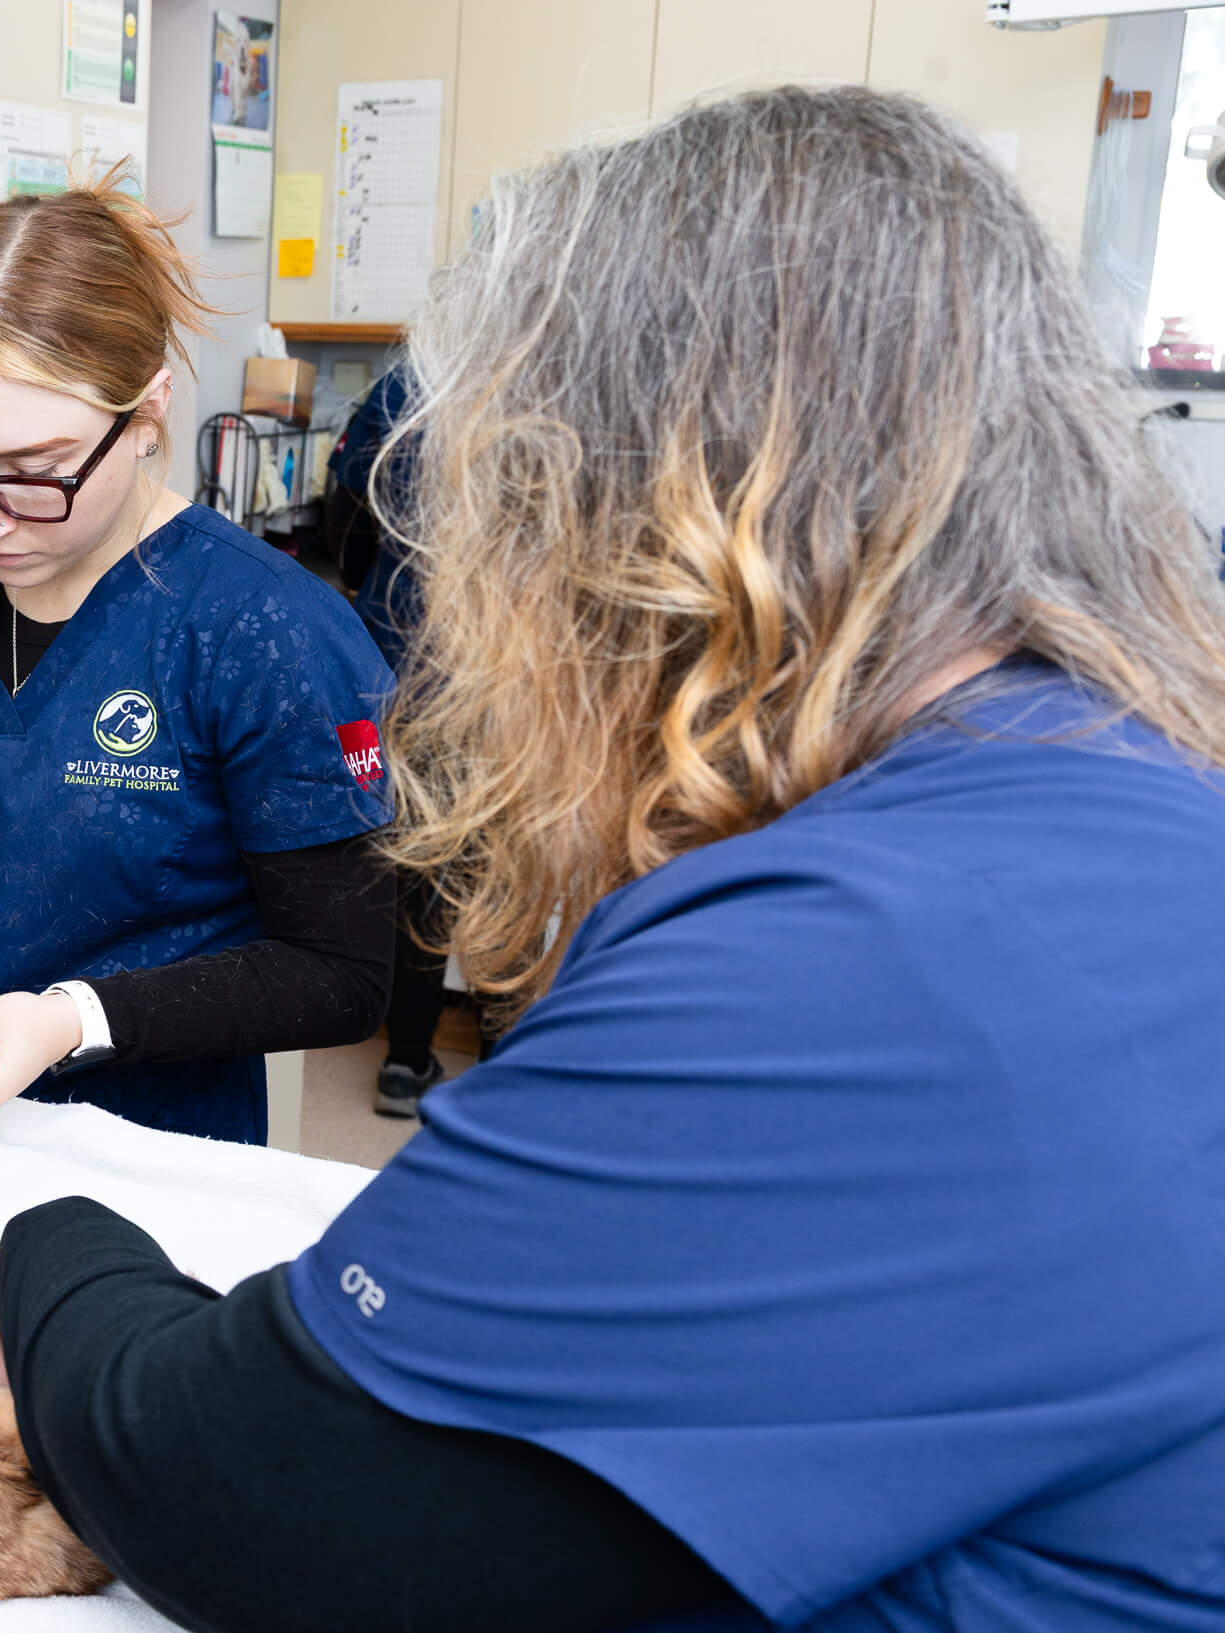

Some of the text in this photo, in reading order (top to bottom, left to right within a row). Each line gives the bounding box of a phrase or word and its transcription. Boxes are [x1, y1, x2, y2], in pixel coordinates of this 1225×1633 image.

[76, 760, 170, 780] LIVERMORE
[64, 774, 180, 791] FAMILY PET HOSPITAL
